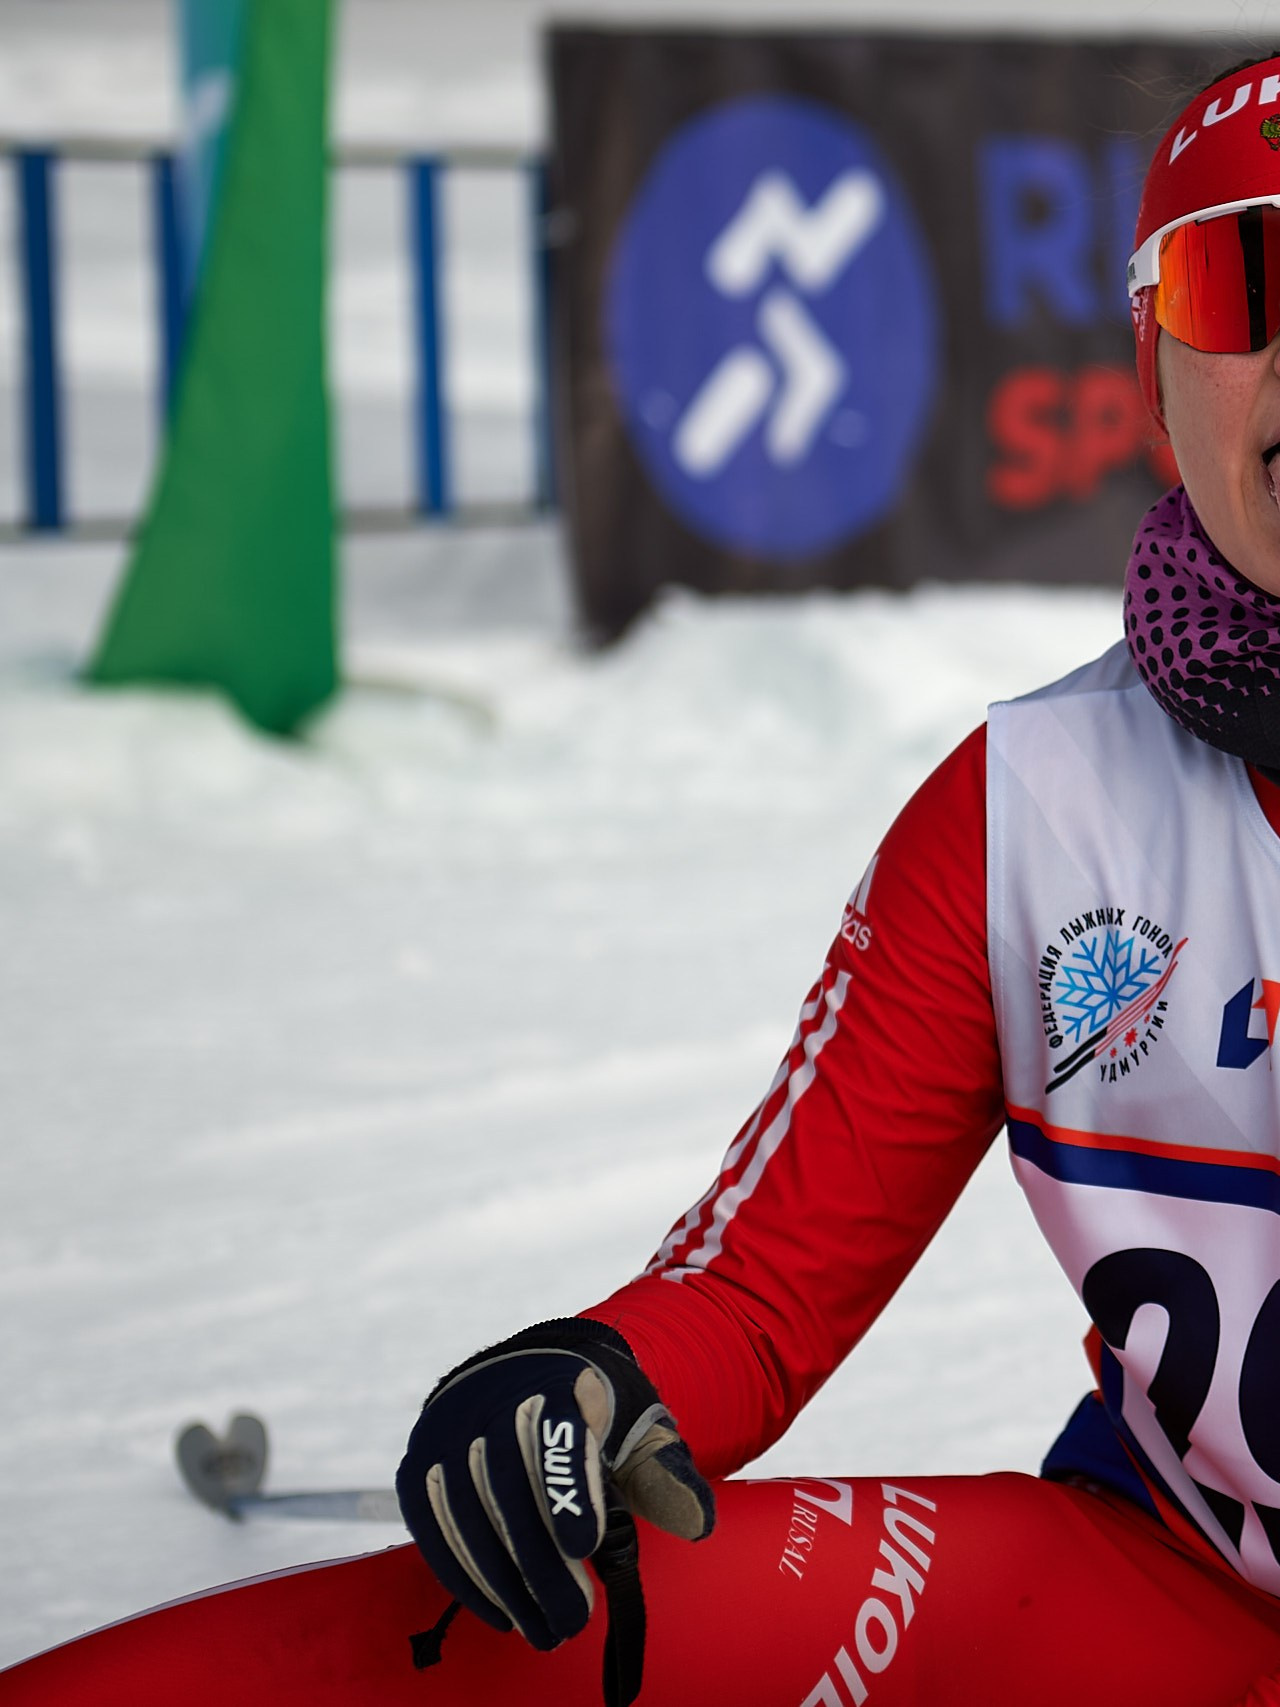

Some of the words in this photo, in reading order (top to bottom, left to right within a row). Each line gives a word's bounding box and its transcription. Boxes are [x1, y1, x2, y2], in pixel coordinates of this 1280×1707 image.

[1038, 944, 1063, 1049] ФЕДЕРАЦИЯ
[1132, 915, 1174, 959] ГОНОК
[1099, 1000, 1169, 1084] УДМУРТИИ
[543, 1419, 582, 1516] SWIX
[778, 1502, 818, 1581] RUSAL
